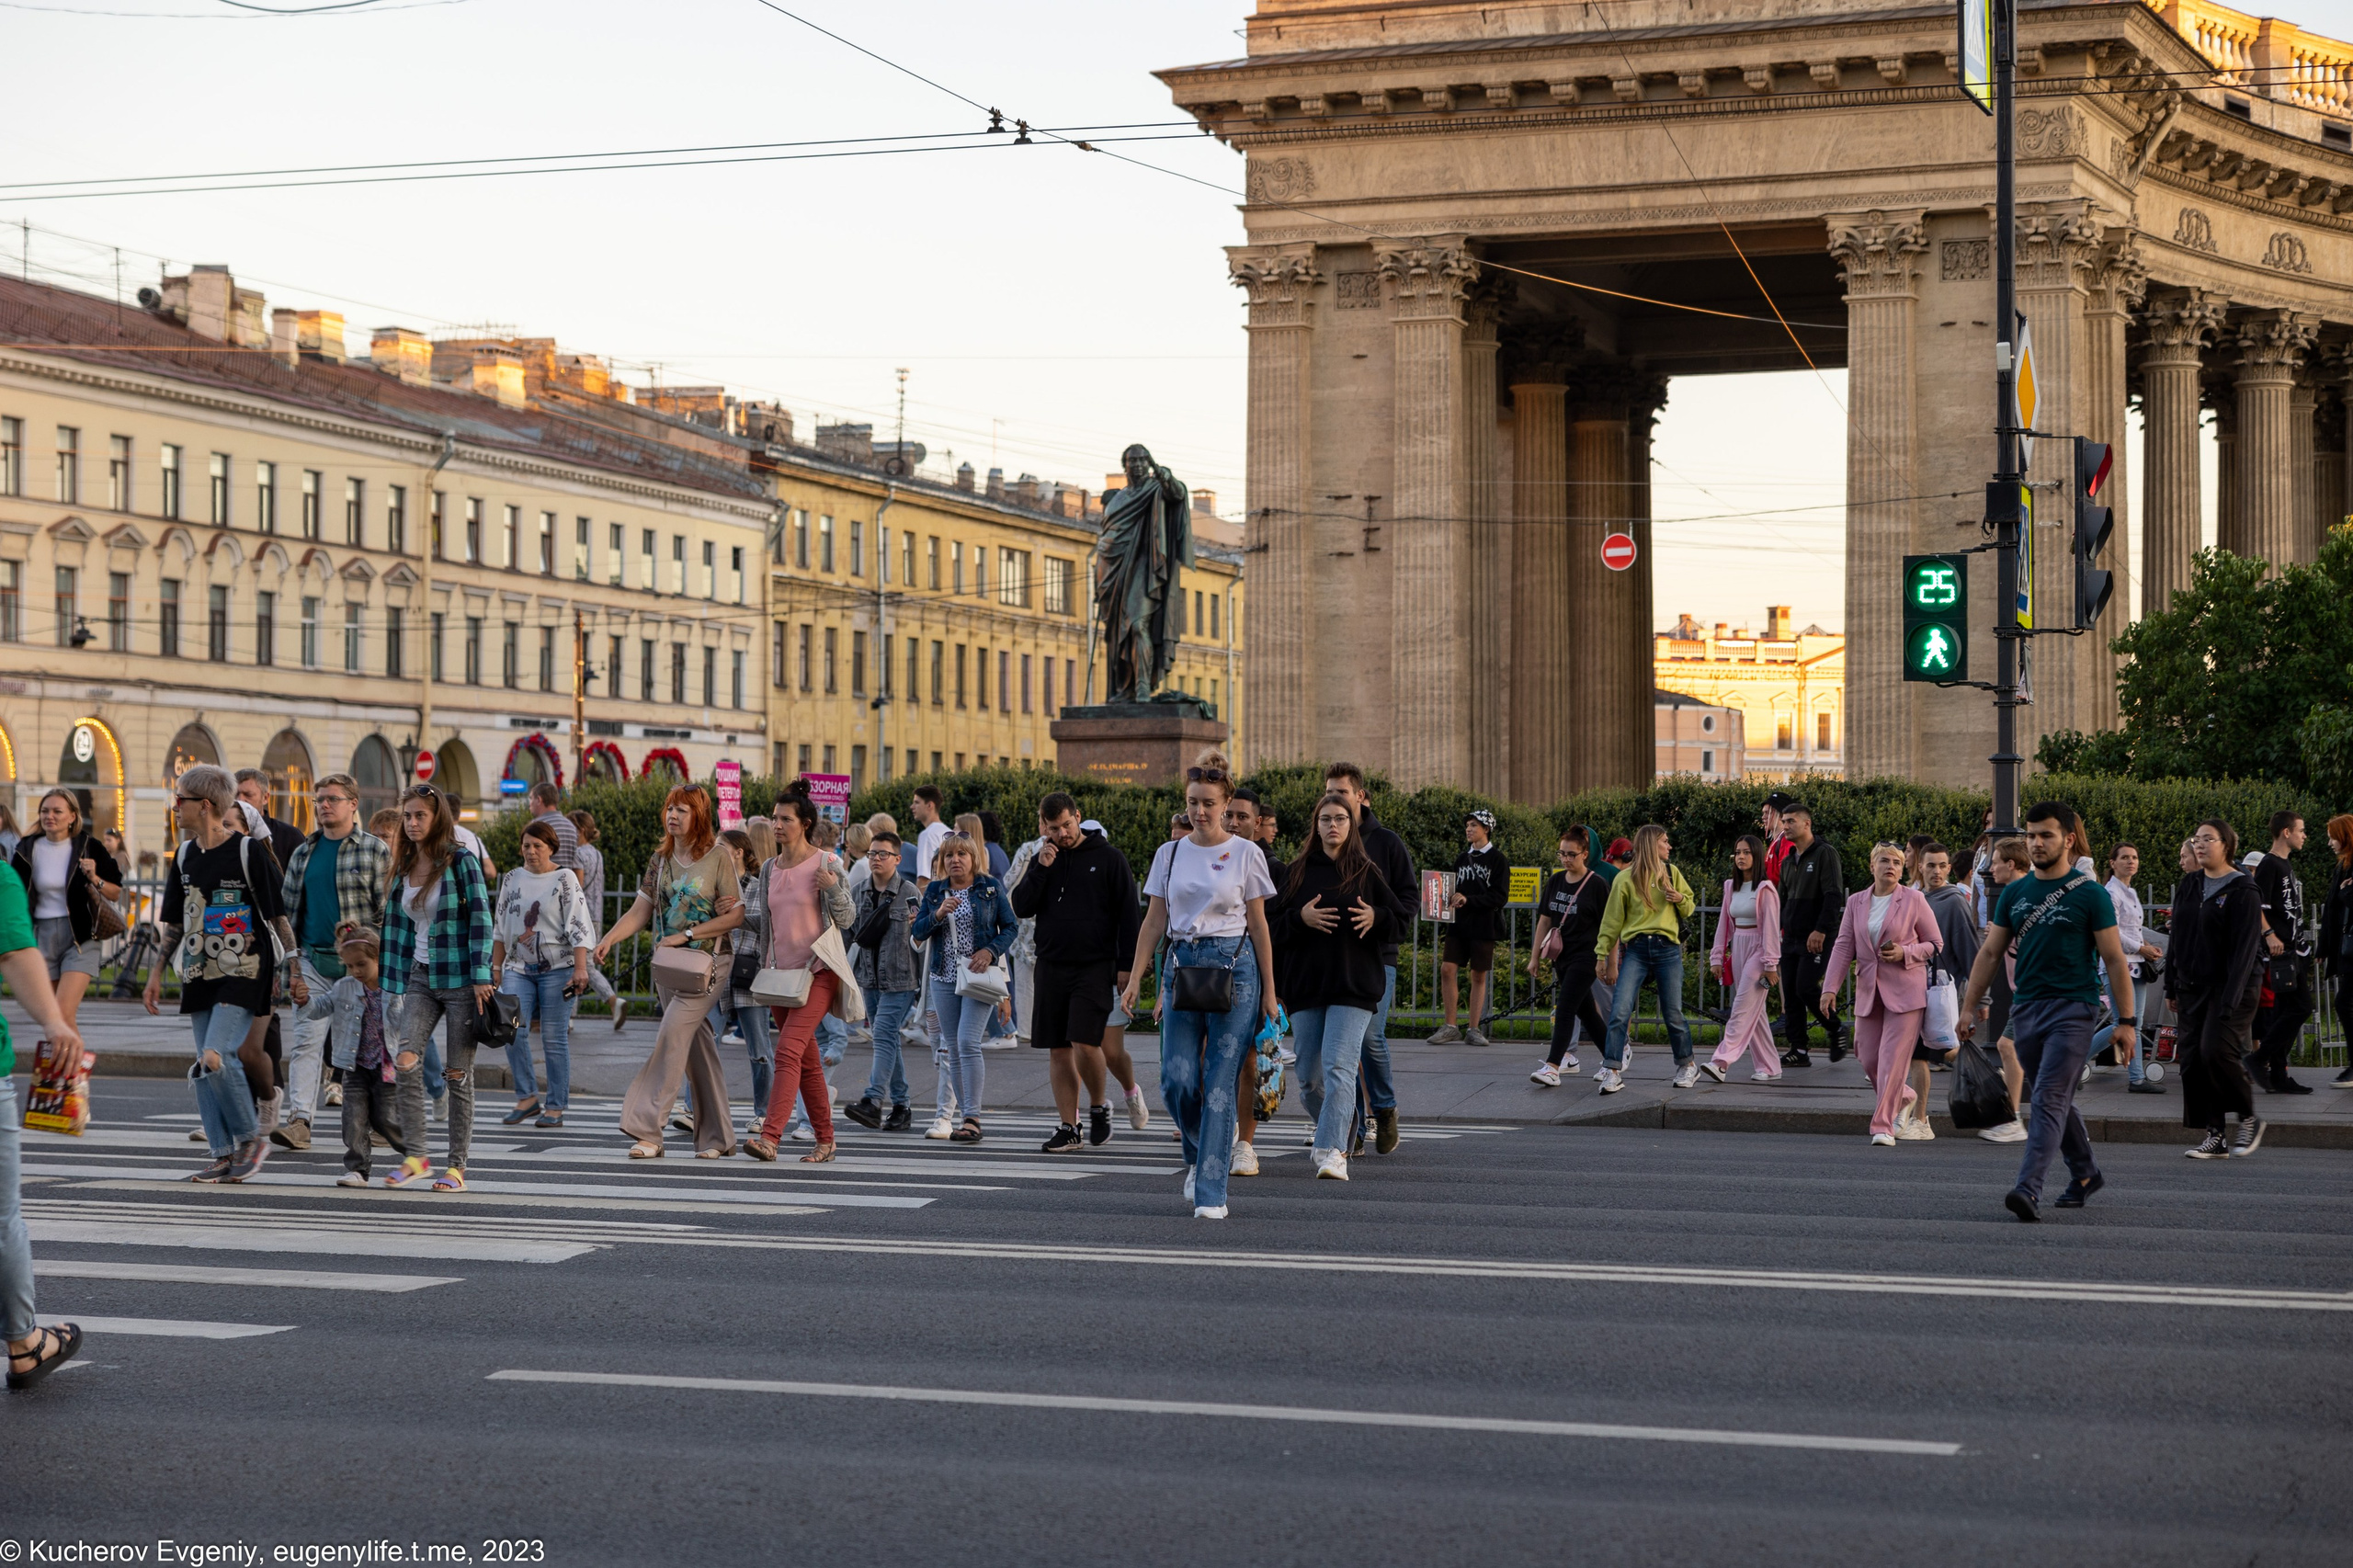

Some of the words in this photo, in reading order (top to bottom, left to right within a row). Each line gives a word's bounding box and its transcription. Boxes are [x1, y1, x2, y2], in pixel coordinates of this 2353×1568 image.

[1919, 570, 1955, 603] 25
[716, 769, 740, 782] ПУШКИН
[810, 780, 849, 794] БЗОРНАЯ
[508, 902, 521, 917] day
